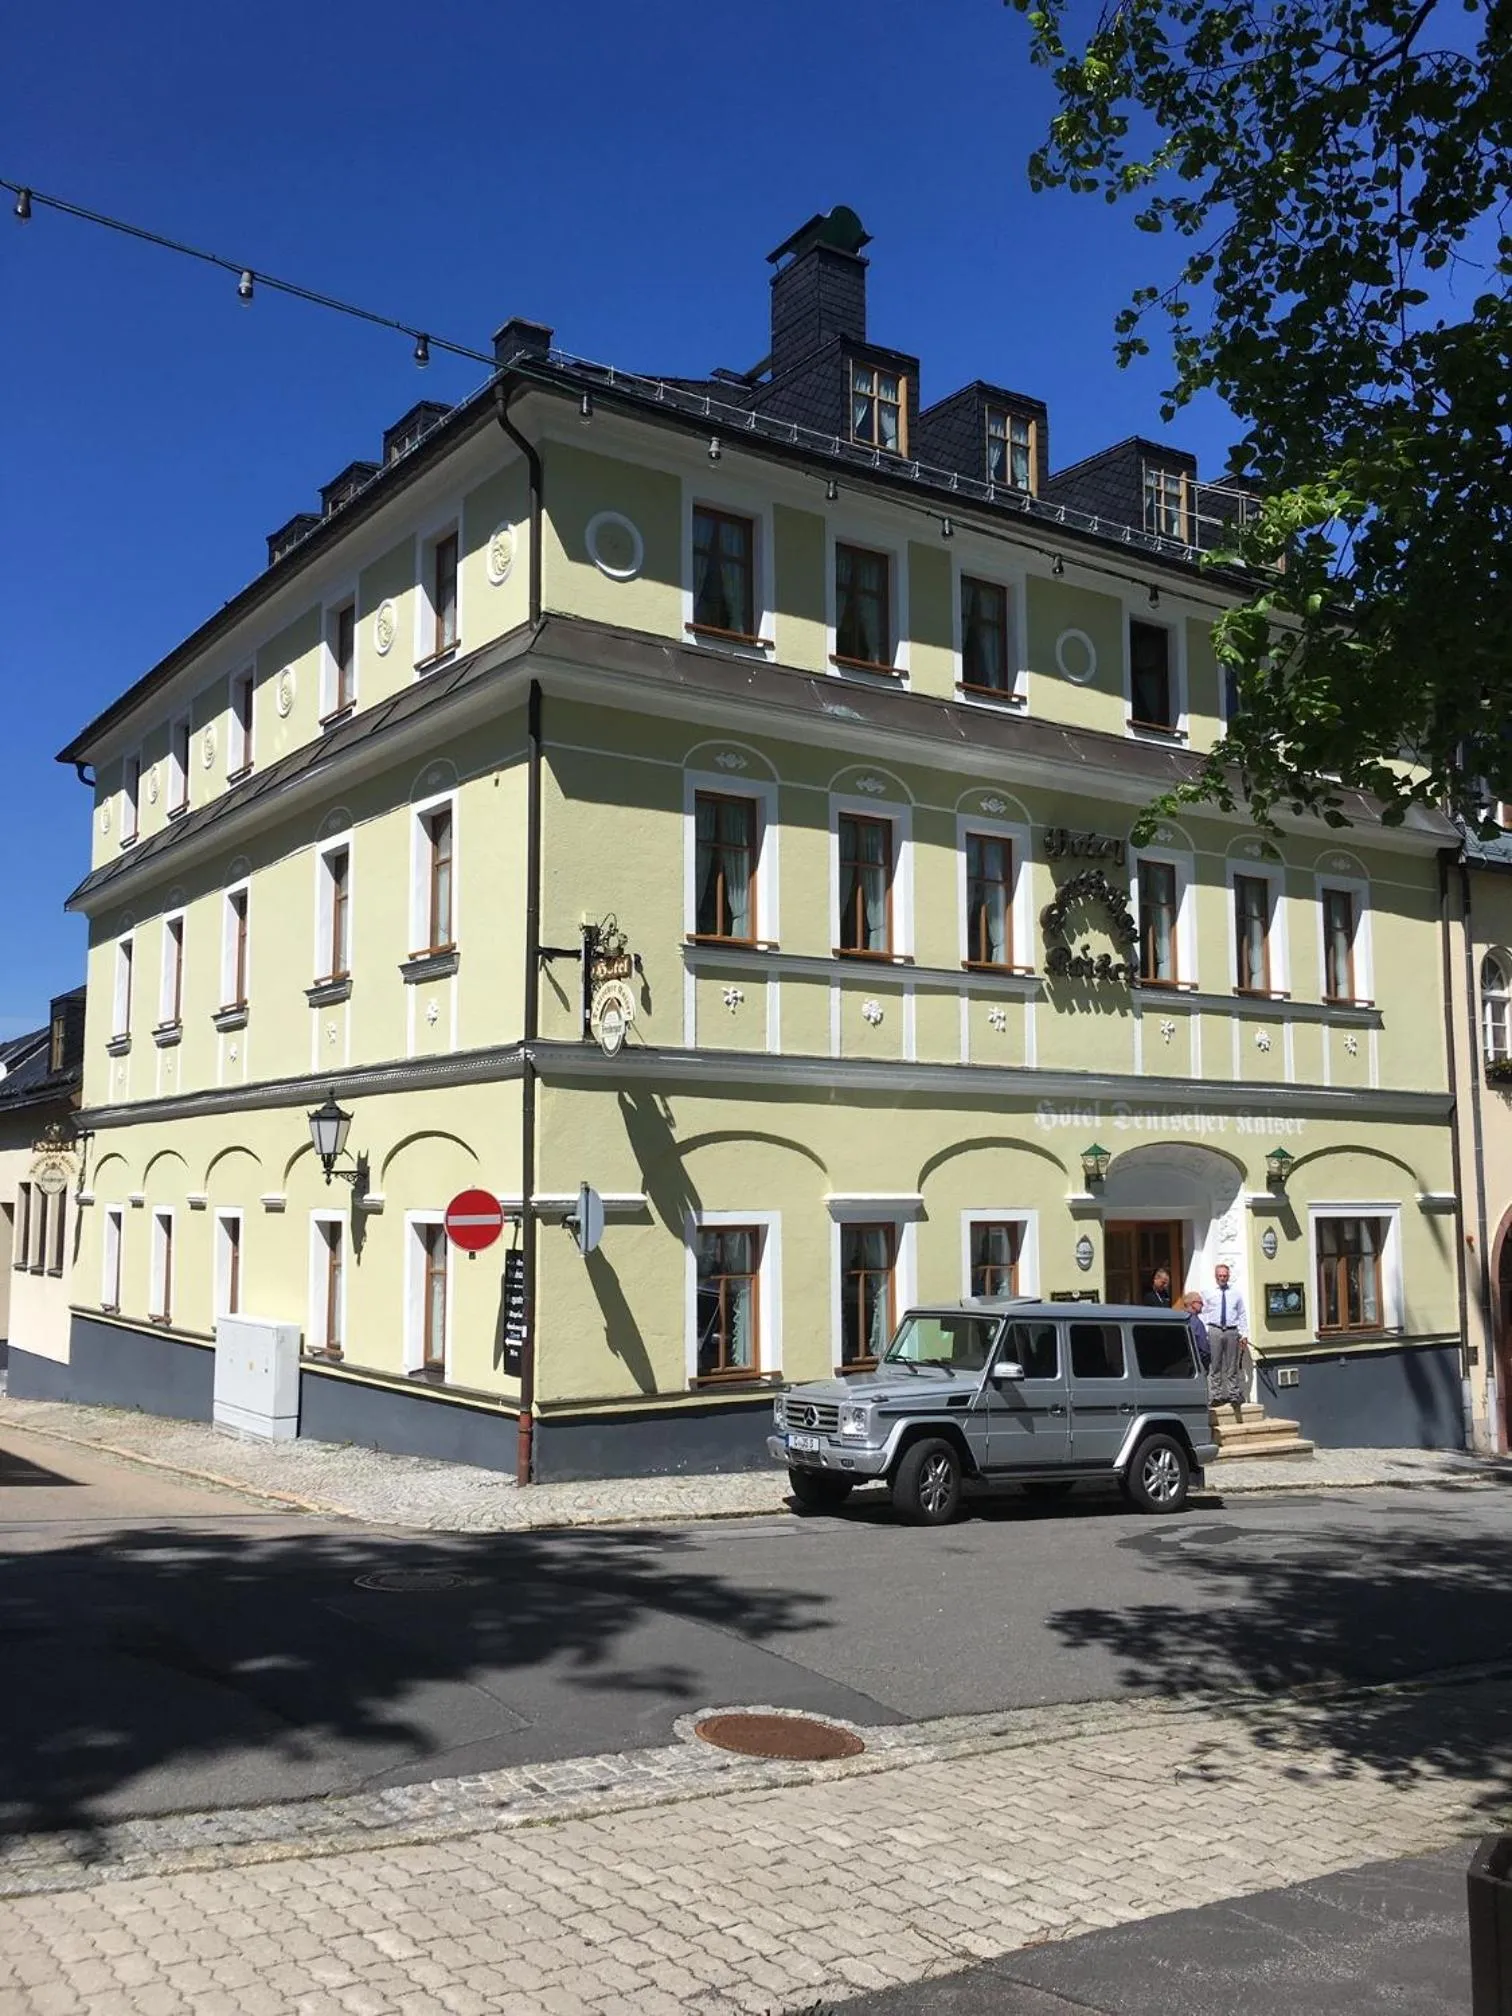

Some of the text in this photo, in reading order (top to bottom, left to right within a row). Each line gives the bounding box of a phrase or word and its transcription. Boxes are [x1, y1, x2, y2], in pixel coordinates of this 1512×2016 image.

[1034, 1099, 1306, 1139] Hotel Deutscher Kaiser
